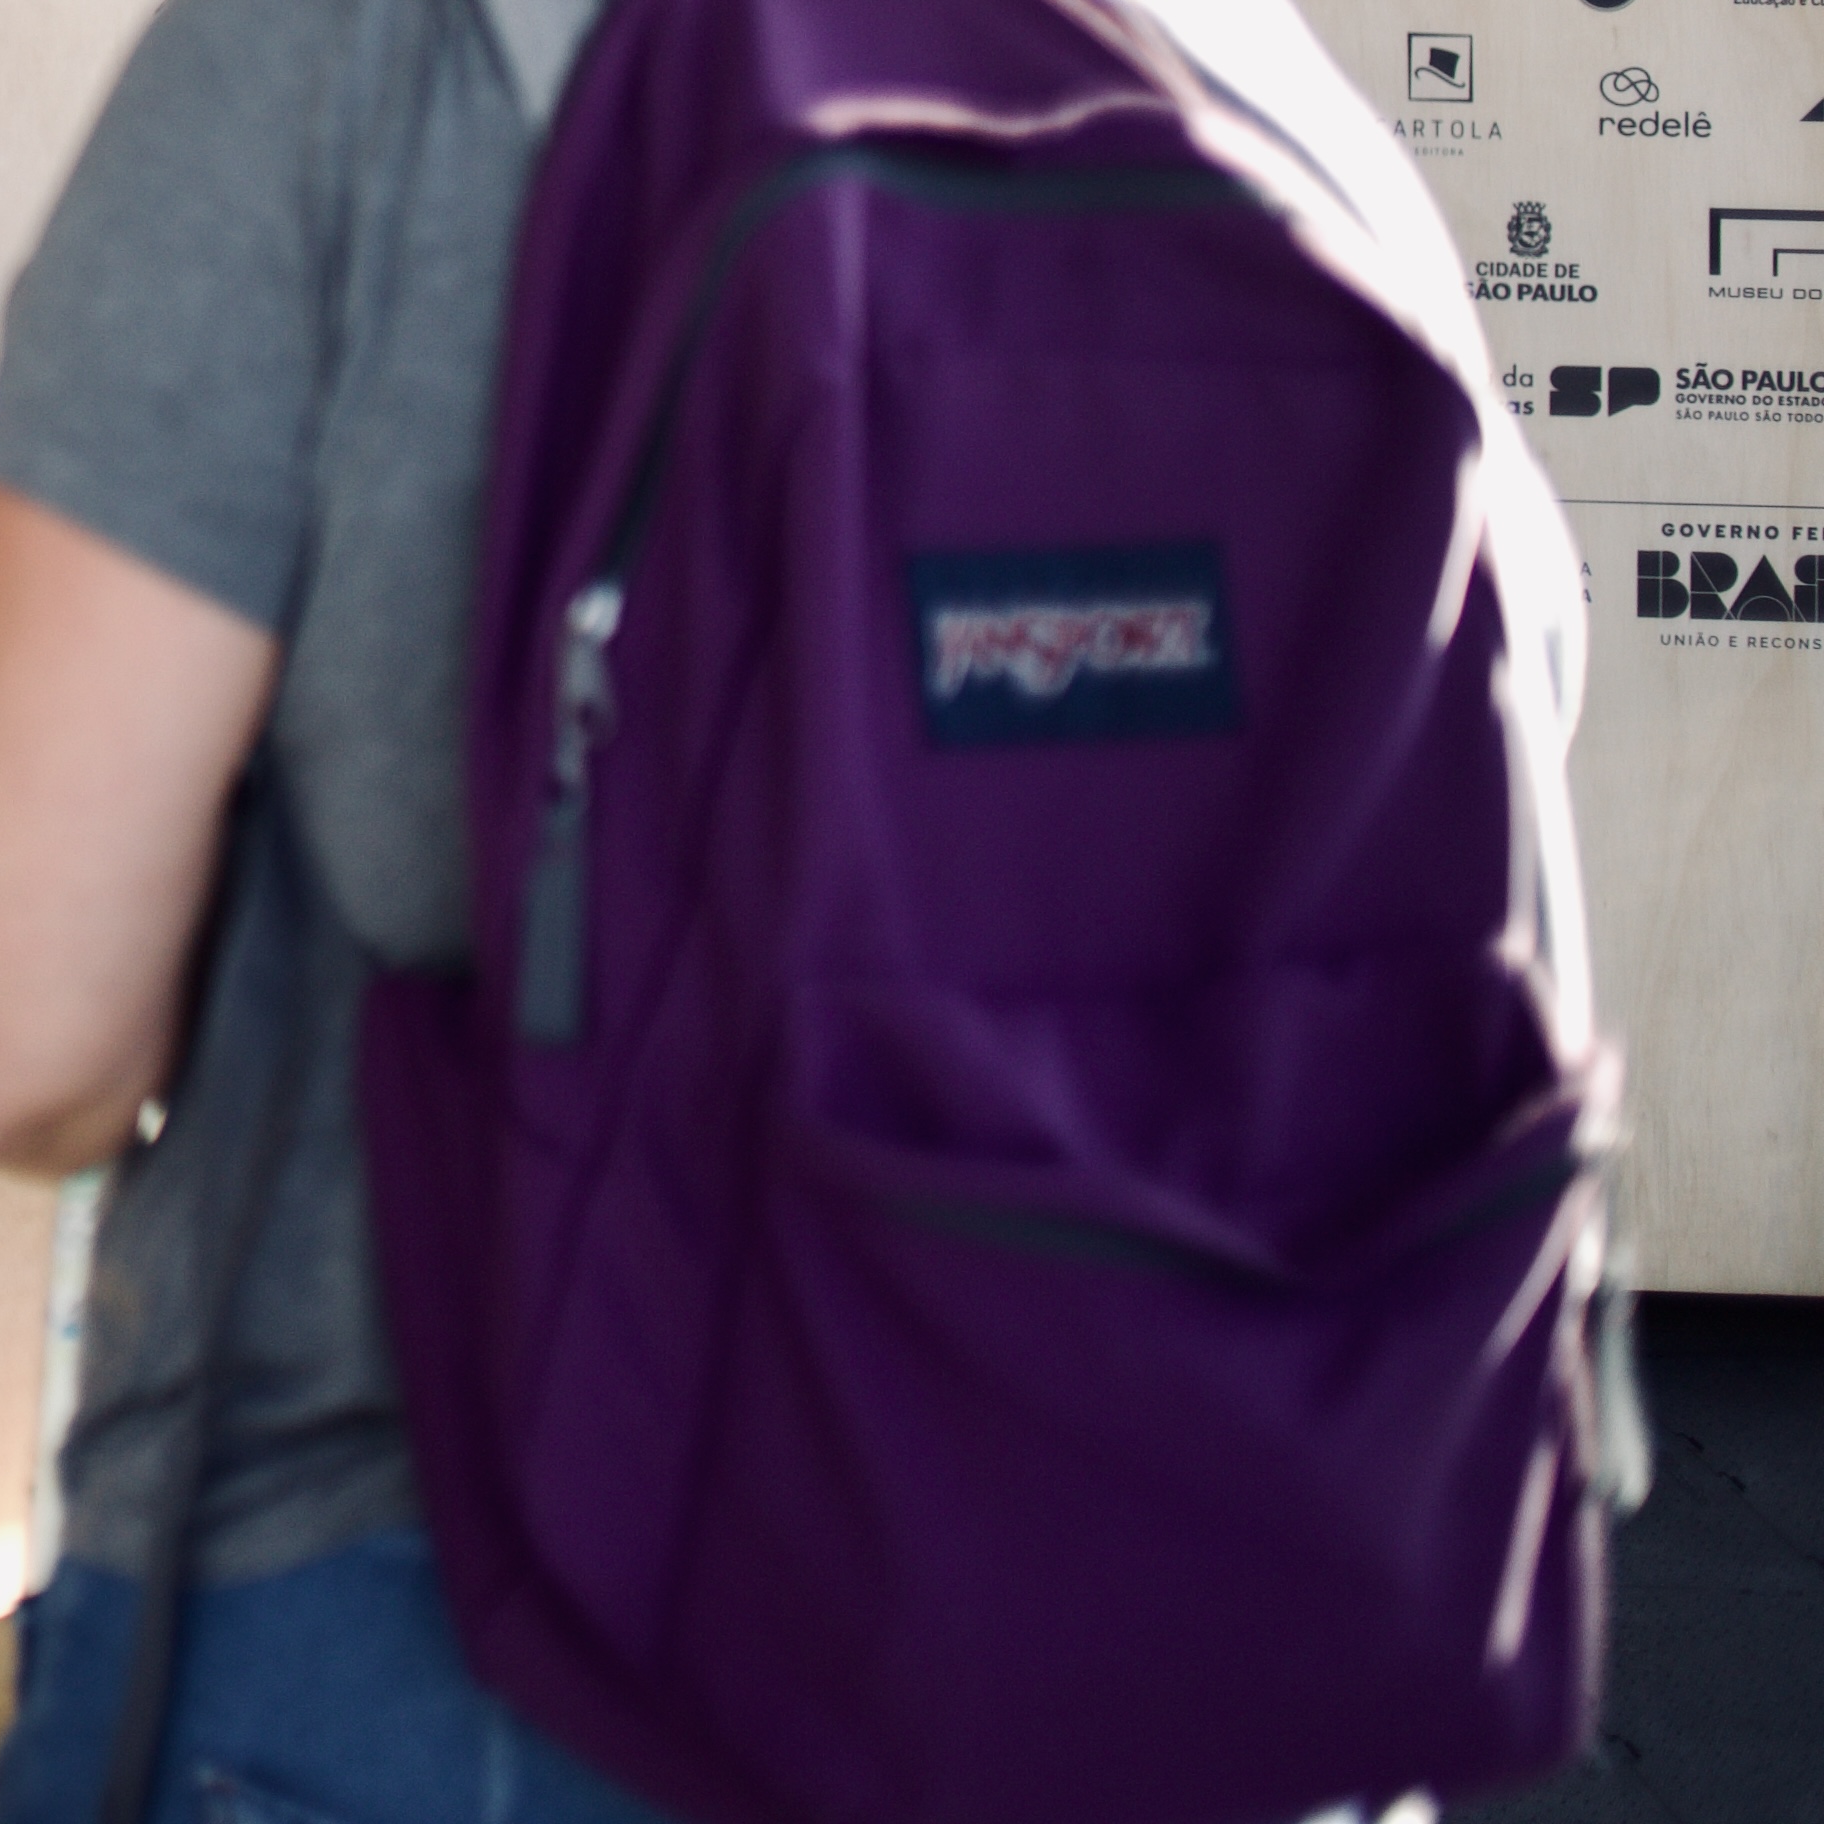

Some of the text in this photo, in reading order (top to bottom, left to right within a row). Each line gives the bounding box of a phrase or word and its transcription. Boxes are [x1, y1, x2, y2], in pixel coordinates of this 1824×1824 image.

[1599, 110, 1712, 138] redelê
[1476, 262, 1580, 278] CIDADE DE
[1517, 283, 1598, 303] PAULO
[1708, 285, 1824, 300] MUSEU DO
[1502, 364, 1534, 388] da
[1675, 363, 1734, 391] SÃO
[1675, 392, 1775, 407] GOVERNO DO
[1675, 408, 1782, 423] SÃO PAULO SÃO
[1661, 522, 1780, 541] GOVERNO
[1660, 632, 1720, 647] UNIÃO
[1728, 635, 1738, 647] E
